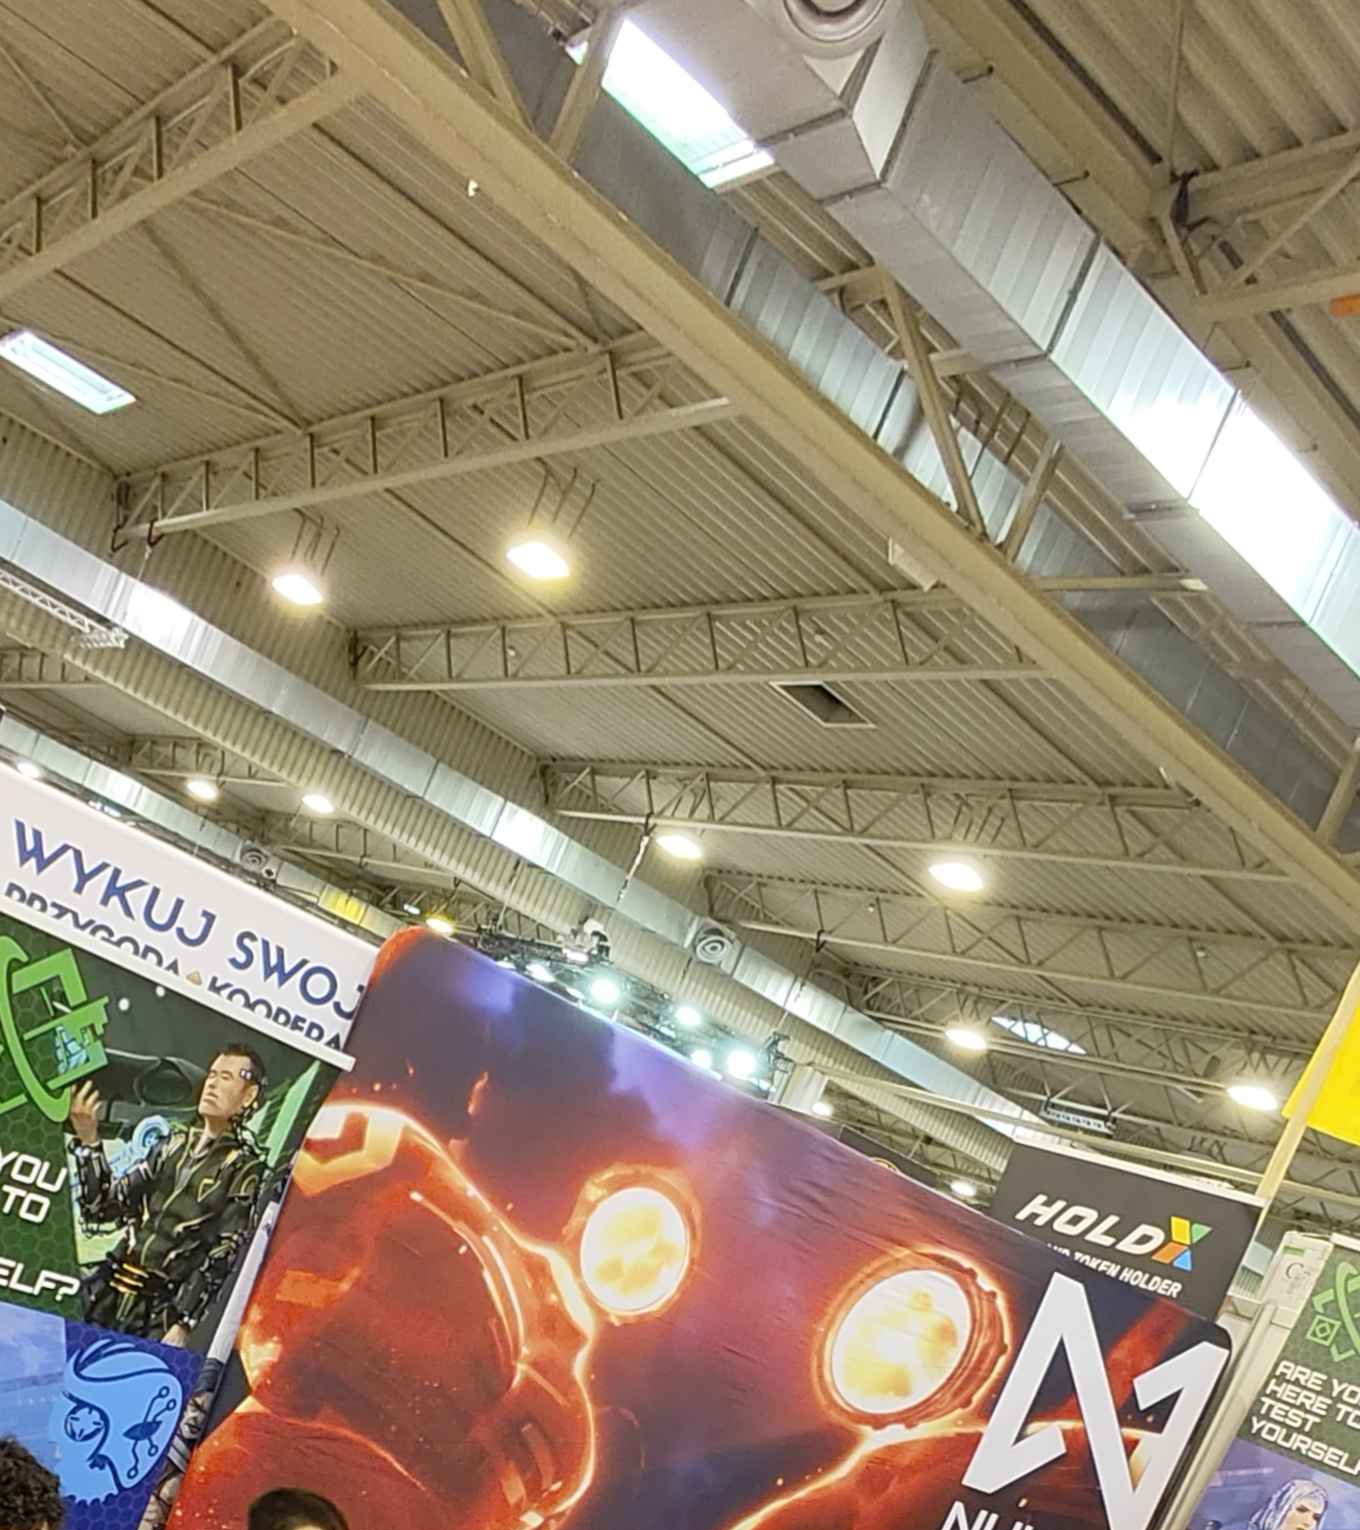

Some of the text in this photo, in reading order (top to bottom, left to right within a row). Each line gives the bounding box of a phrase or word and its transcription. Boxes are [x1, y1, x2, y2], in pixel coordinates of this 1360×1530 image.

[14, 818, 217, 948] WYKUJ
[1, 1184, 51, 1224] TO
[1119, 1267, 1183, 1298] HOLDER
[1275, 1360, 1328, 1391] ARE
[1260, 1396, 1321, 1432] TEST
[1265, 1378, 1333, 1416] HERE
